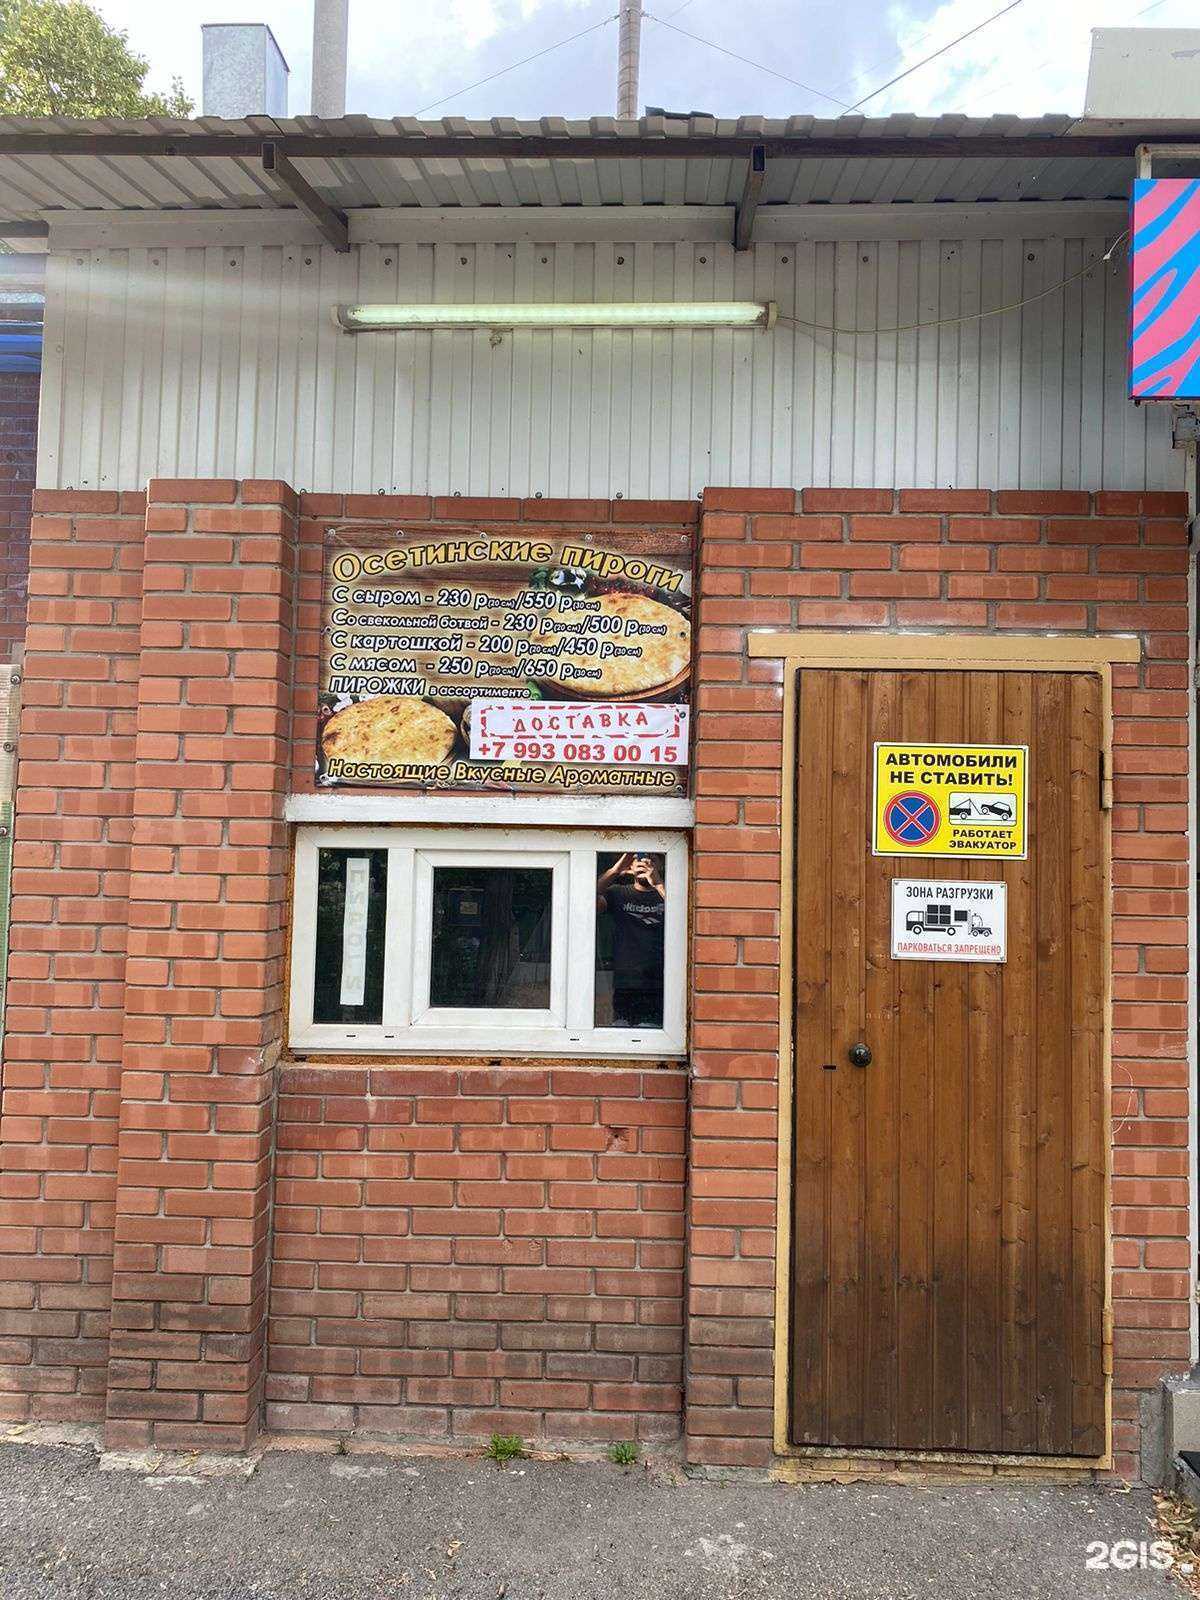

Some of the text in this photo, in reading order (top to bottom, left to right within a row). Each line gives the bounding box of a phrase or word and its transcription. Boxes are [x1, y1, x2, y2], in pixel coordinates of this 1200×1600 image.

[332, 541, 683, 592] Осетинские пироги
[332, 586, 349, 603] С
[352, 590, 421, 608] сыром
[437, 589, 471, 606] 230
[331, 608, 357, 625] Со
[358, 615, 438, 628] свекольной
[439, 615, 488, 629] ботвой
[503, 614, 537, 631] 230
[331, 630, 348, 648] С
[351, 634, 462, 652] картошкой
[479, 636, 513, 652] 200
[330, 653, 347, 671] С
[349, 657, 417, 672] мясом
[438, 656, 472, 674] 250
[329, 675, 531, 699] ПИРОЖКИ в ассортименте
[513, 712, 649, 733] ДОСТАВКА
[478, 742, 678, 763] +7 993 083 00 15
[885, 753, 1017, 768] АВТОМОБИЛИ
[327, 758, 676, 787] Настоящие Вкусные Ароматные
[890, 771, 1013, 786] НЕ СТАВИТЬ!
[953, 829, 1013, 839] РАБОТАЕТ
[949, 840, 1017, 850] ЭВАКУАТОР
[906, 886, 993, 900] ЗОНА РАЗГРУЗКИ
[897, 942, 1001, 955] ПАРКОВАТЬСЯ ЗАПРЕЩЕНО
